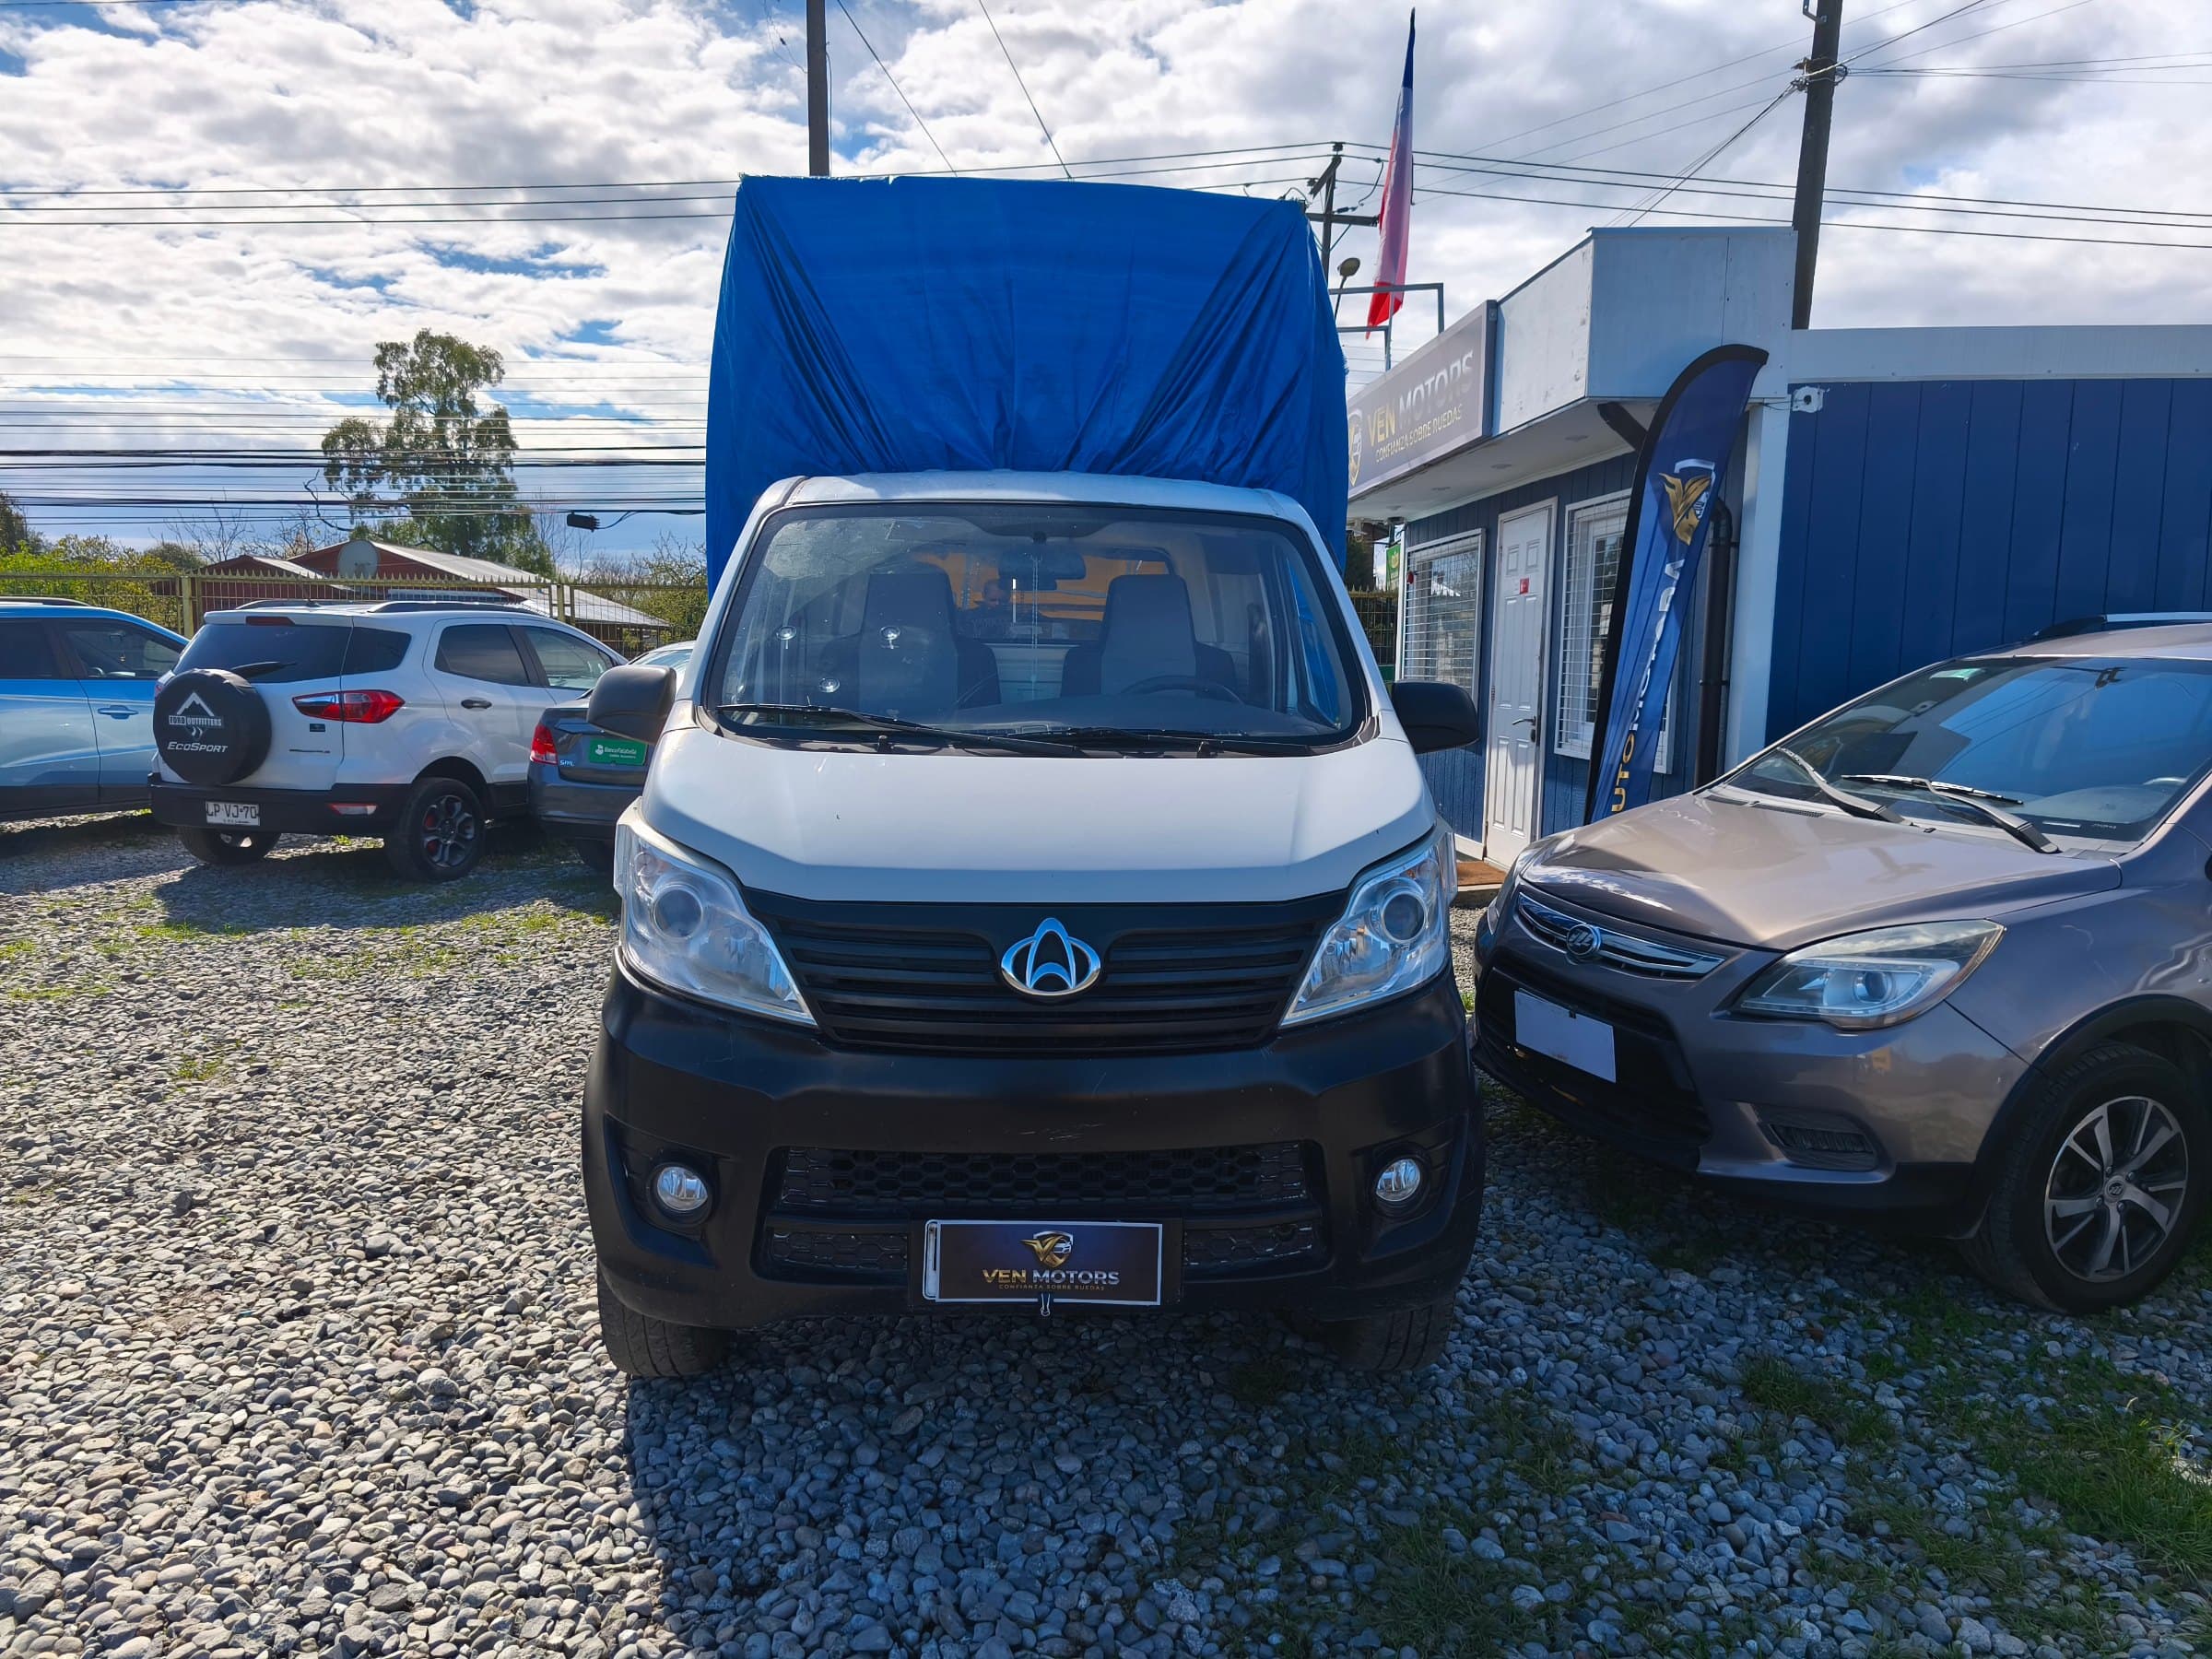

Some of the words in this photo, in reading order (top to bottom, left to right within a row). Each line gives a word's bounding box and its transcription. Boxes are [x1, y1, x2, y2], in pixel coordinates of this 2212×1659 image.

[1368, 400, 1395, 447] VEN
[1398, 349, 1475, 430] MOTORS
[1376, 434, 1409, 463] CONFIANZA
[1410, 419, 1432, 446] SOBRE
[1433, 404, 1464, 435] RUEDAS
[186, 717, 222, 726] OUTFITTERS
[982, 1268, 1027, 1284] VEN
[1032, 1269, 1121, 1285] MOTORS
